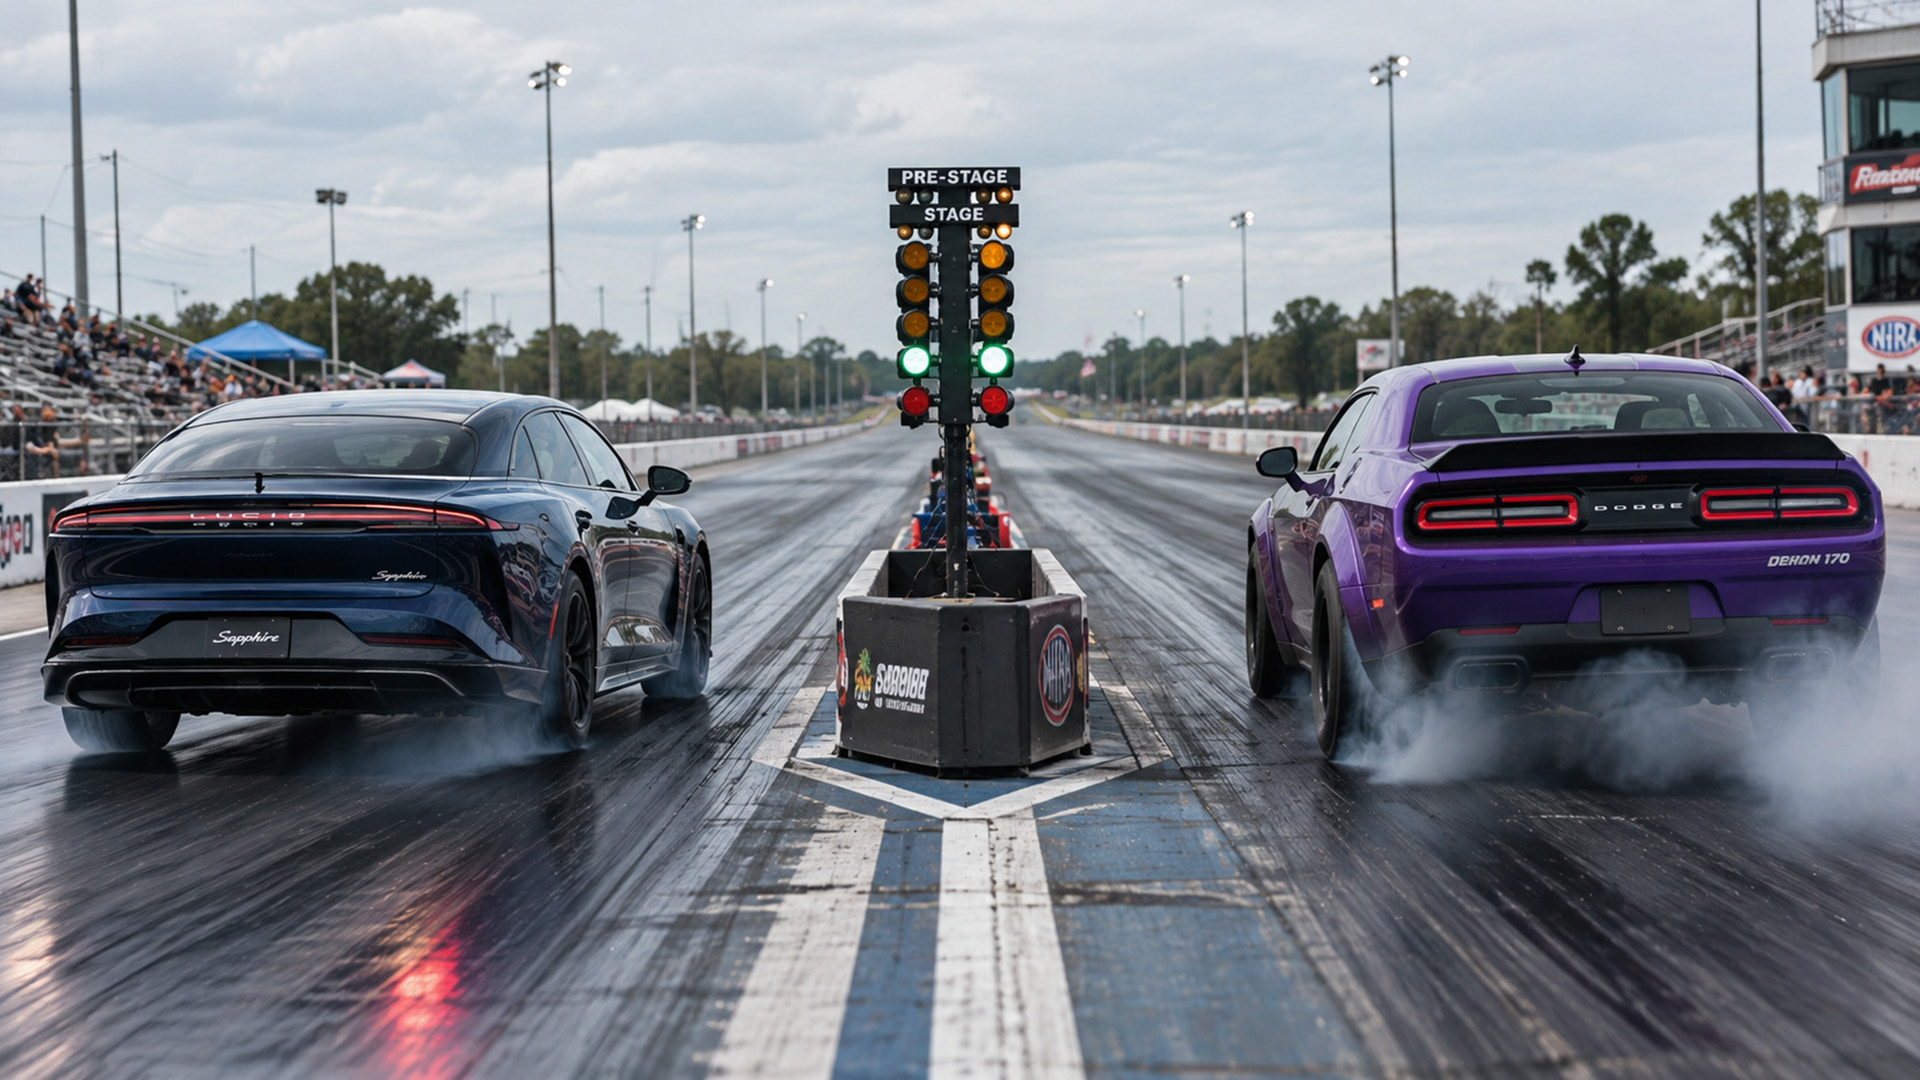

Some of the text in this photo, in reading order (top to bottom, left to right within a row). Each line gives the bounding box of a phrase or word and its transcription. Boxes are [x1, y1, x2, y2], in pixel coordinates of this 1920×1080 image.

[902, 169, 1008, 184] PRE-STAGE
[924, 207, 984, 221] STAGE
[1594, 503, 1683, 512] DODGE
[1824, 553, 1850, 565] 170
[212, 630, 279, 647] Sapphire
